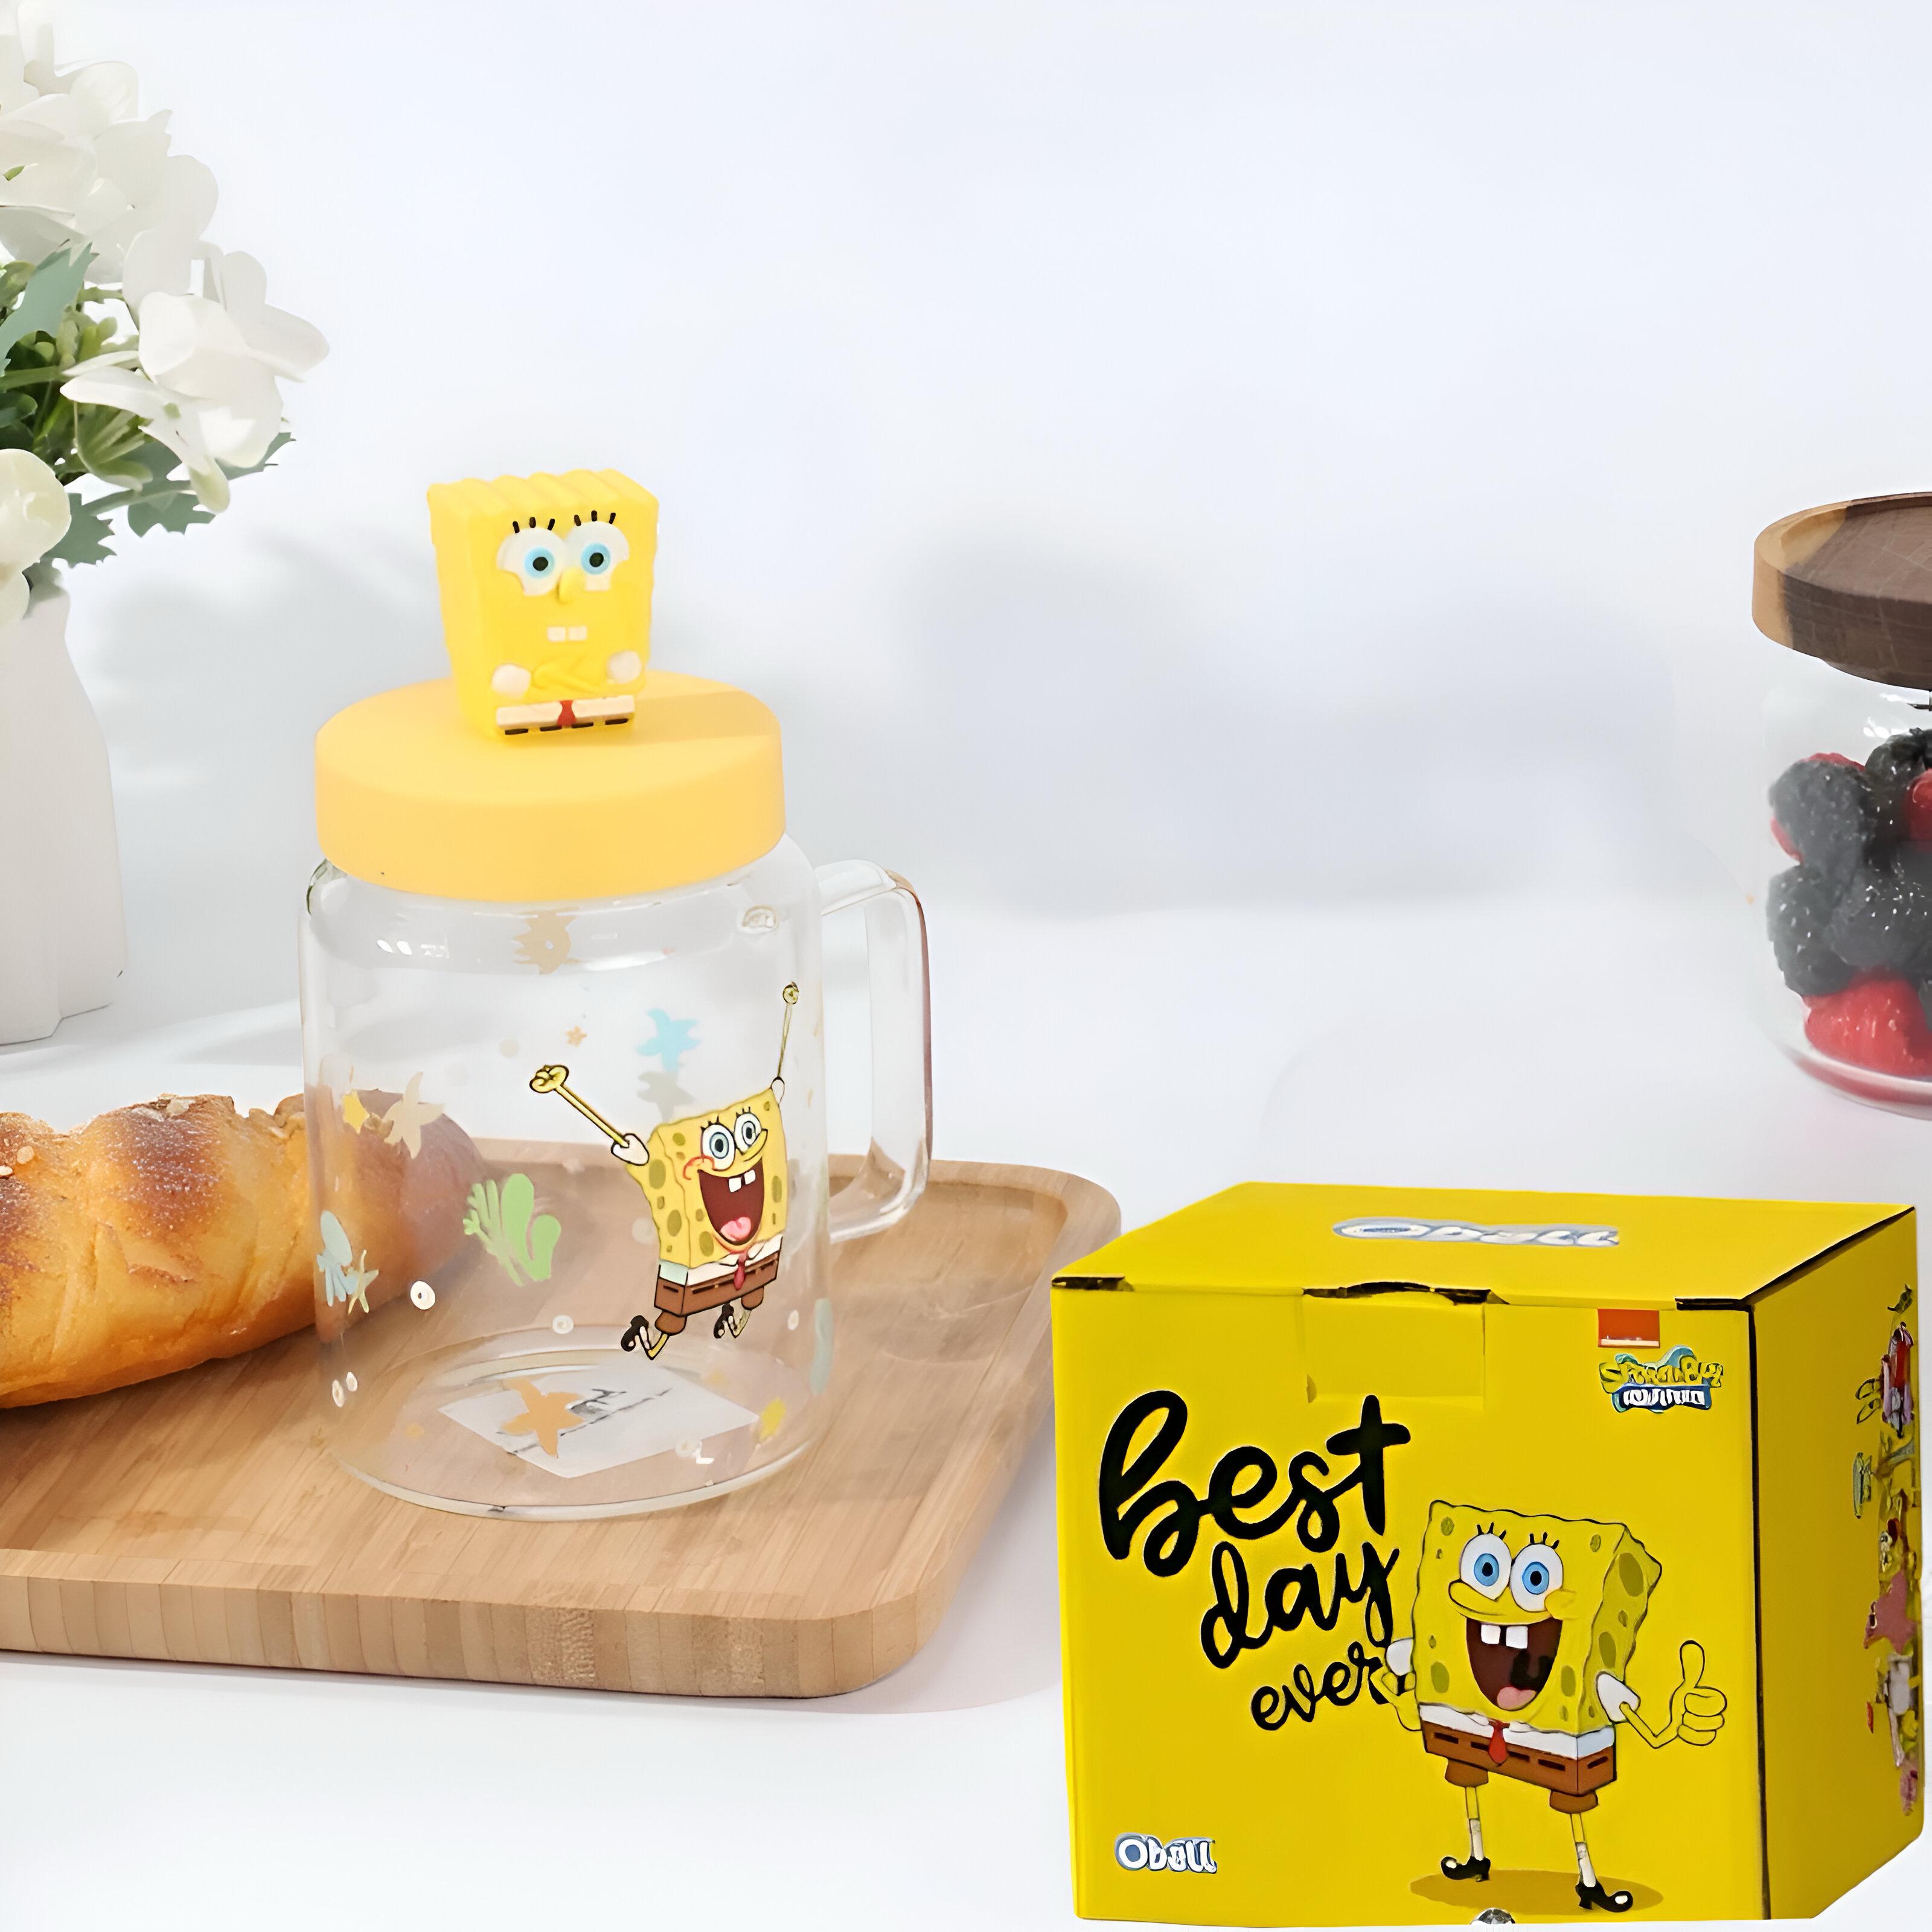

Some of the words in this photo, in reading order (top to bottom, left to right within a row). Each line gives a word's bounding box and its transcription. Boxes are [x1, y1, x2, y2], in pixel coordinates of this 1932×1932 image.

[1099, 1390, 1410, 1577] best
[1201, 1541, 1399, 1668] day
[1251, 1641, 1392, 1730] ever
